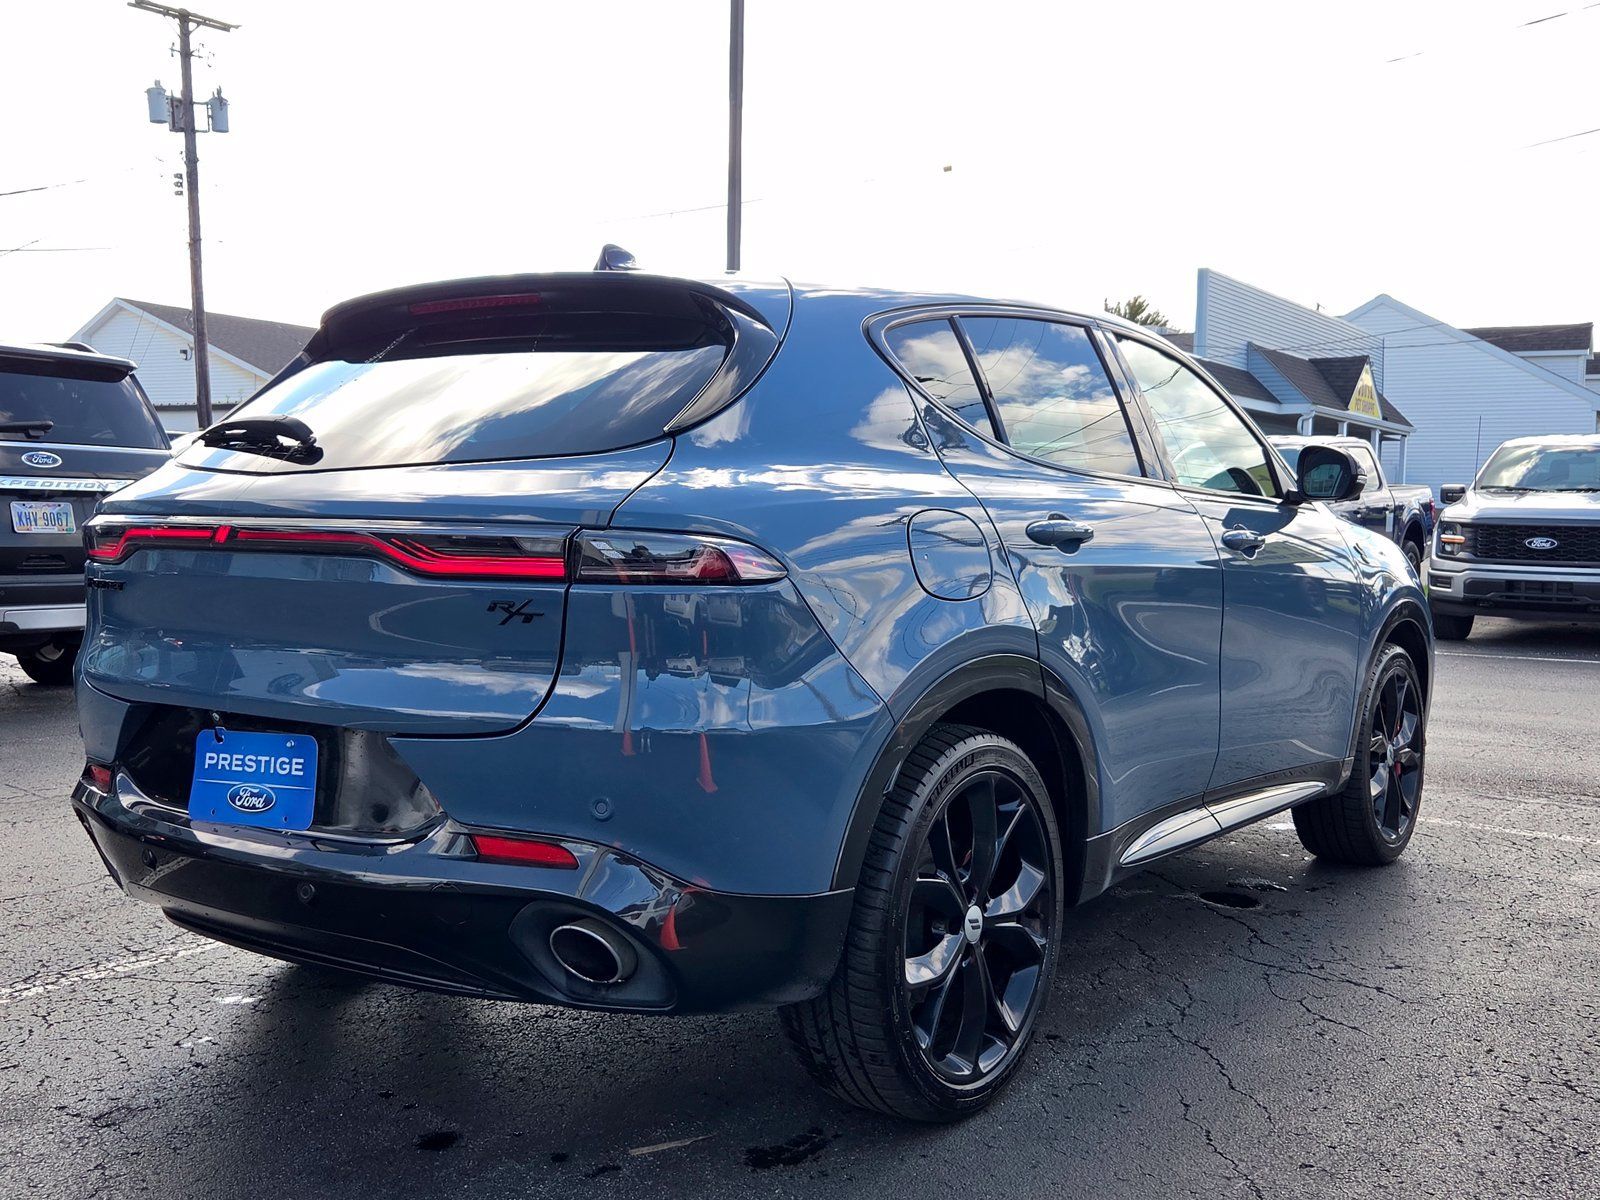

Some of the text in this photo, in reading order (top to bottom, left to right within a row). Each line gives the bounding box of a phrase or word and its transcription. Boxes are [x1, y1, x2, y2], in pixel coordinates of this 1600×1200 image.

[32, 453, 53, 464] Ford
[17, 511, 69, 527] KHV 9067
[486, 599, 544, 626] R/T
[204, 752, 304, 776] PRESTIGE
[235, 786, 267, 808] Ford
